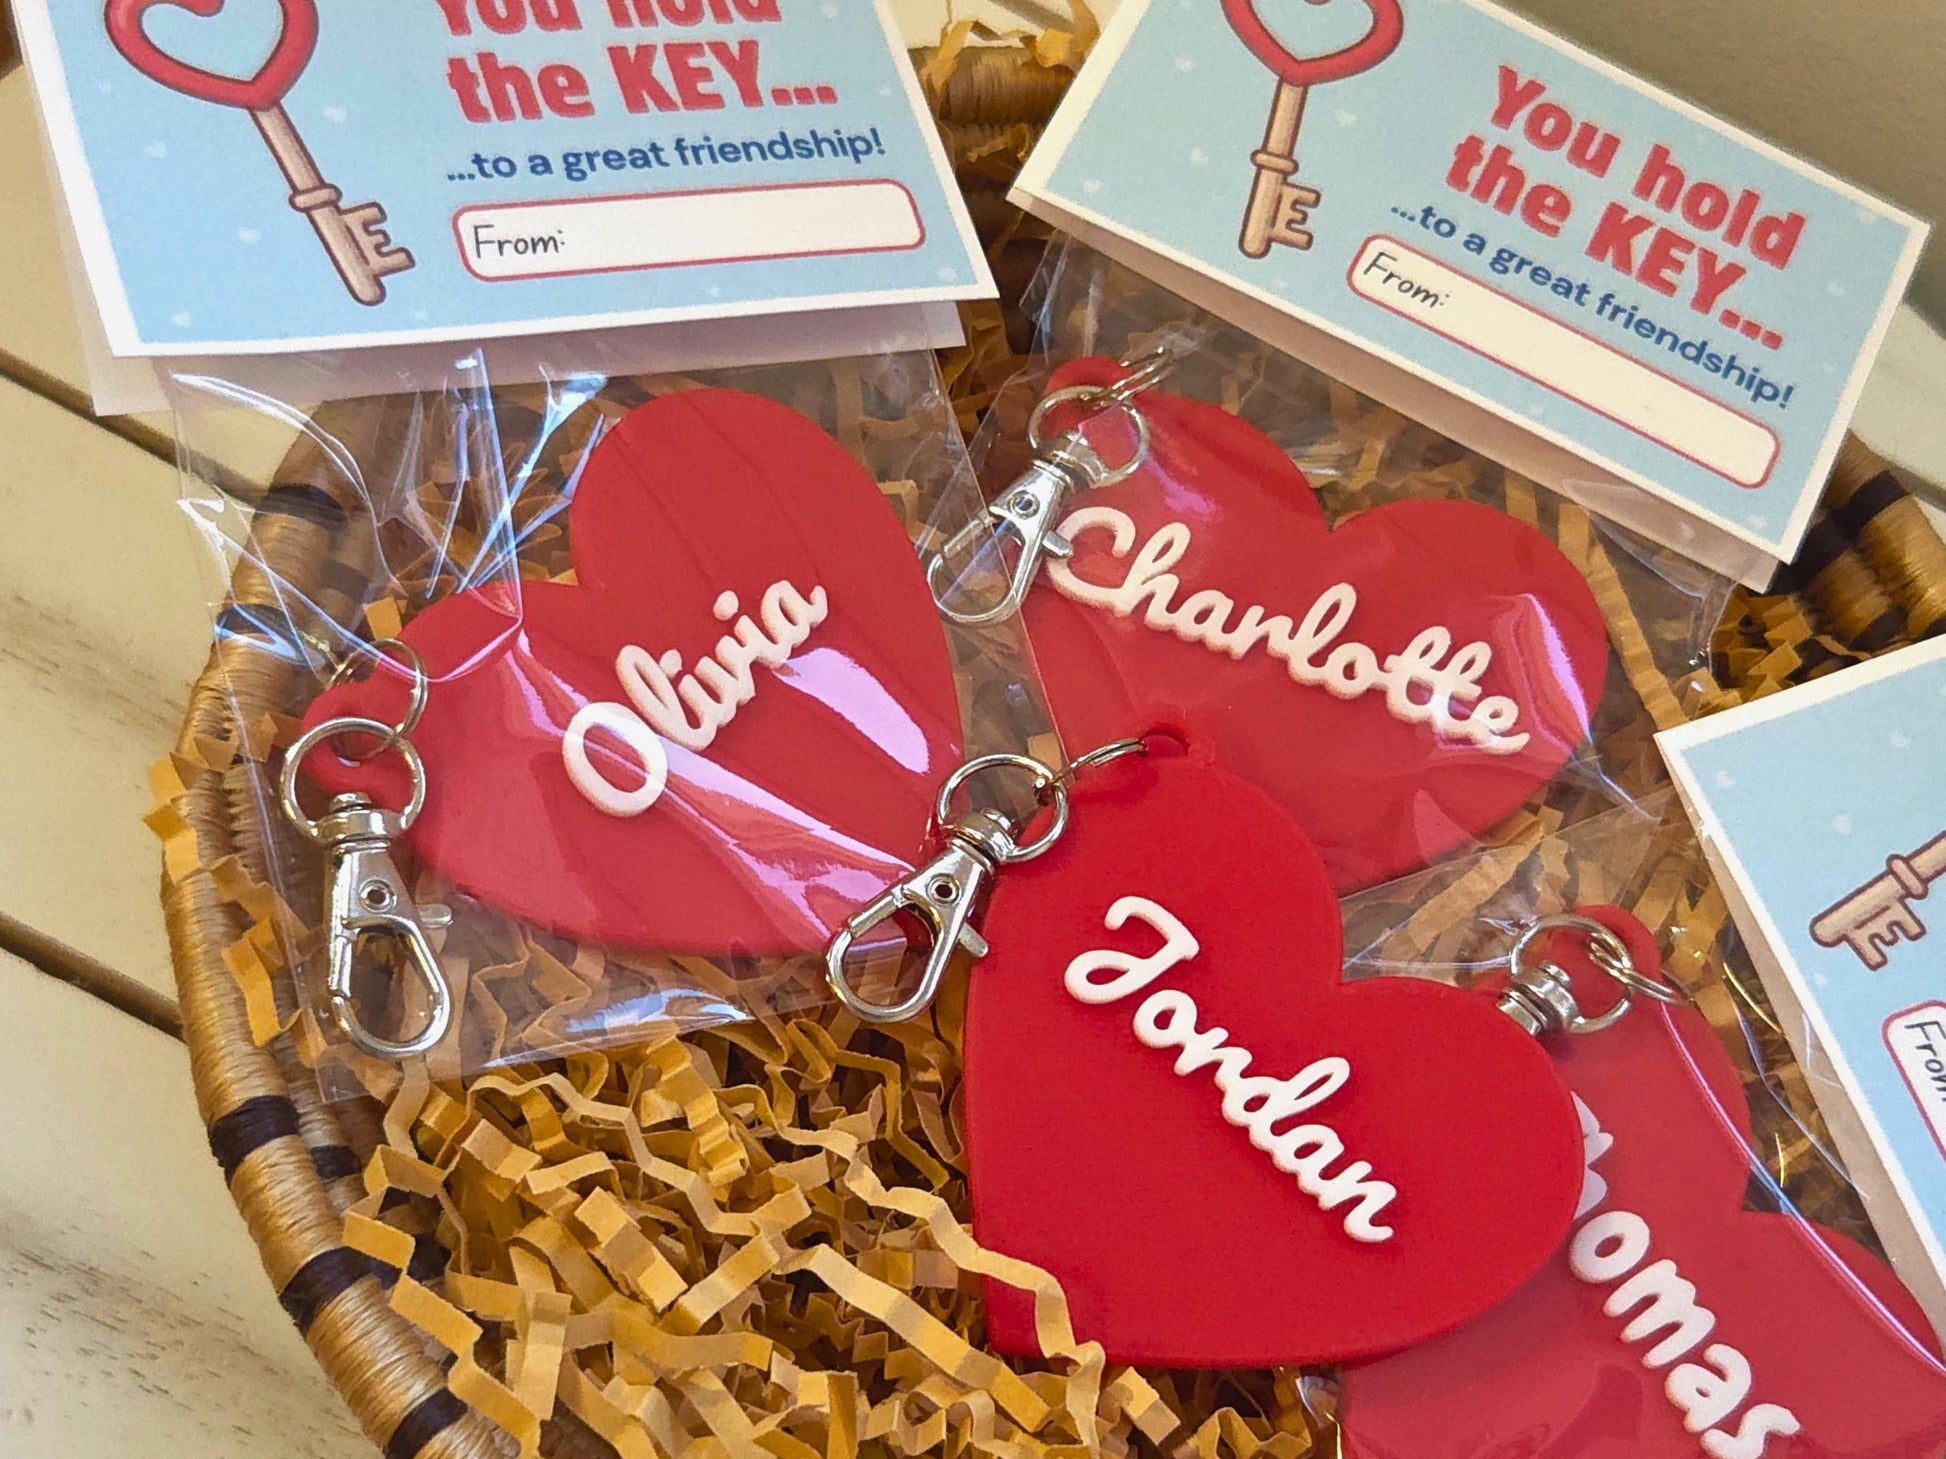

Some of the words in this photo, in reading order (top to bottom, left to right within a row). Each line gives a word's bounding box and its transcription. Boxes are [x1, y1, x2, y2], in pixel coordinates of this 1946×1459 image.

[446, 51, 596, 123] the
[606, 38, 838, 115] KEY...
[446, 152, 517, 181] ...to
[527, 154, 553, 176] a
[564, 141, 668, 182] great
[674, 127, 886, 167] friendship!
[1490, 64, 1622, 178] You
[1632, 142, 1806, 270] hold
[472, 224, 566, 259] From:
[1362, 251, 1450, 309] From:
[1390, 204, 1457, 239] ...to
[1463, 230, 1486, 255] a
[1489, 246, 1591, 307] great
[1595, 293, 1795, 410] friendship!
[1445, 134, 1573, 238] the
[1584, 201, 1784, 350] KEY...
[562, 579, 829, 816] Olivia
[1047, 506, 1531, 756] Charlotte
[1063, 895, 1400, 1243] Jordan
[1567, 1090, 1801, 1459] omas
